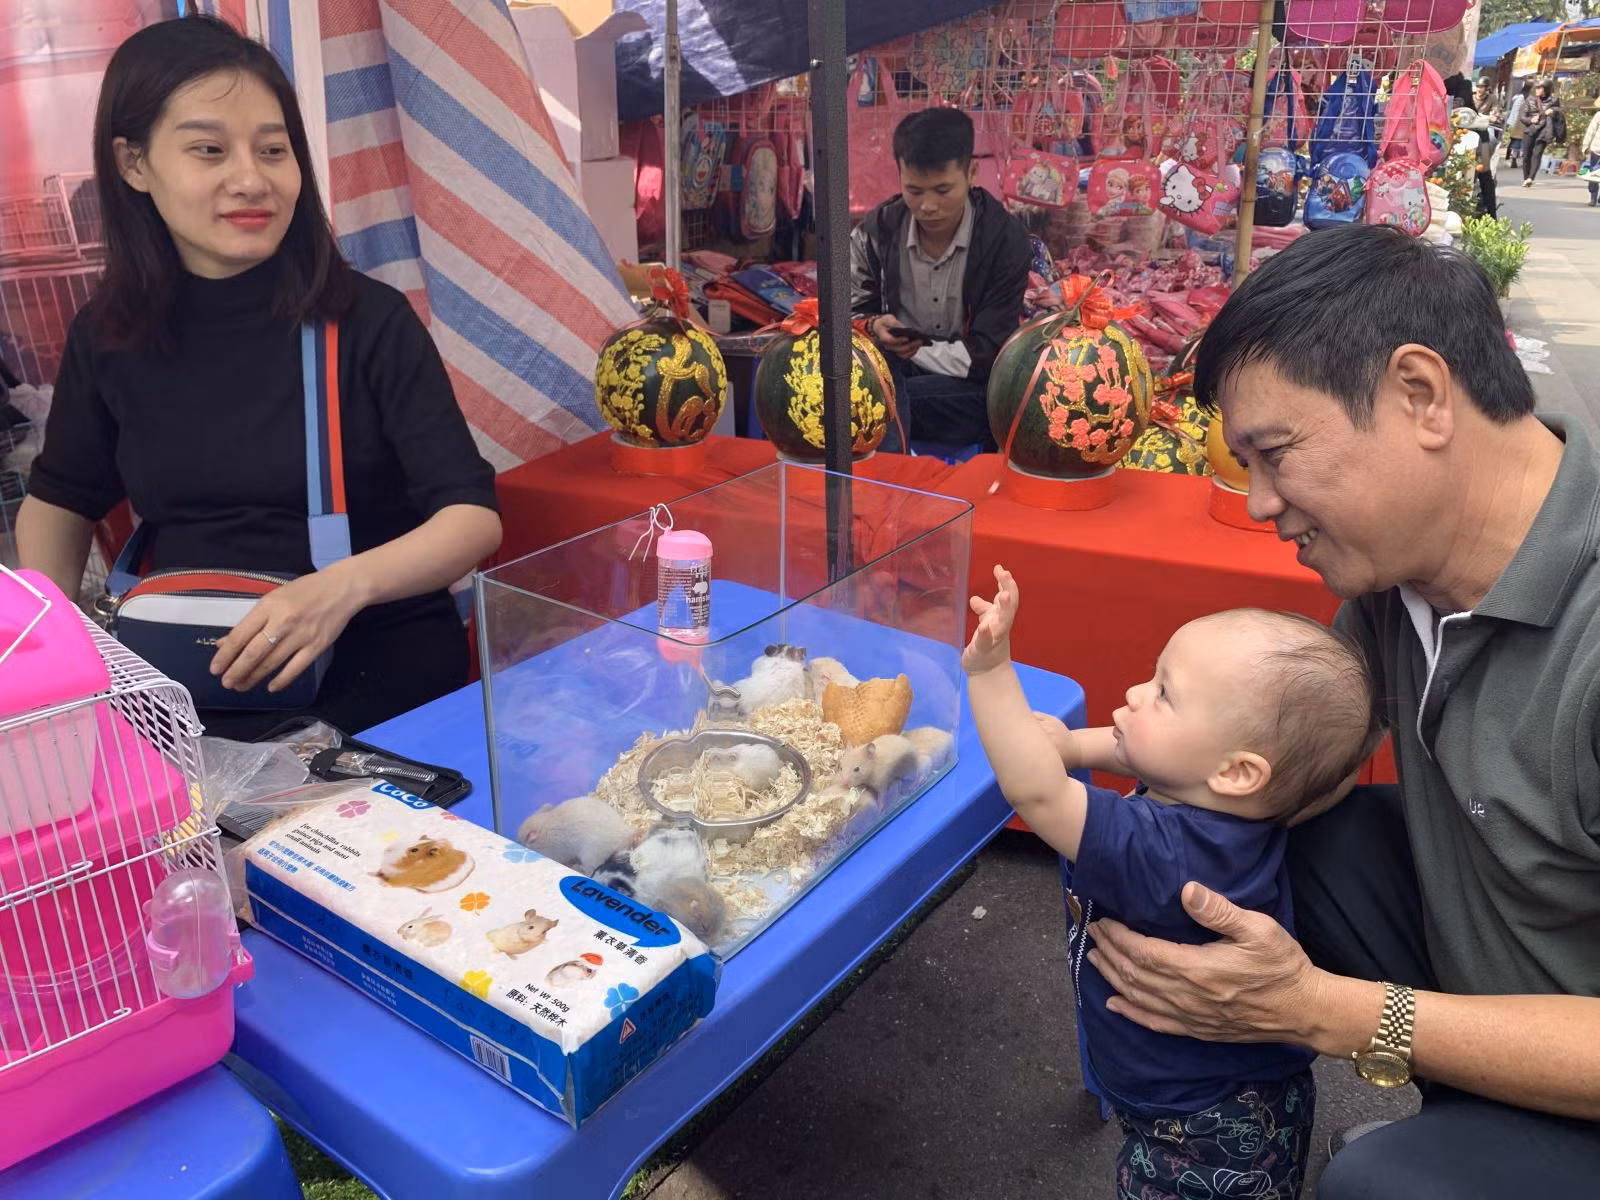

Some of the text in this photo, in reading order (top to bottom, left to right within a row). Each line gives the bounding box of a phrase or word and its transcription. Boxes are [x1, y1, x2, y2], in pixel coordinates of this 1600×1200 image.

[285, 833, 302, 843] small
[299, 840, 321, 854] animals
[292, 828, 350, 860] guinea pigs and most
[300, 822, 360, 857] for chinchillas rabbits
[571, 880, 671, 935] Lavender
[525, 983, 540, 993] Net
